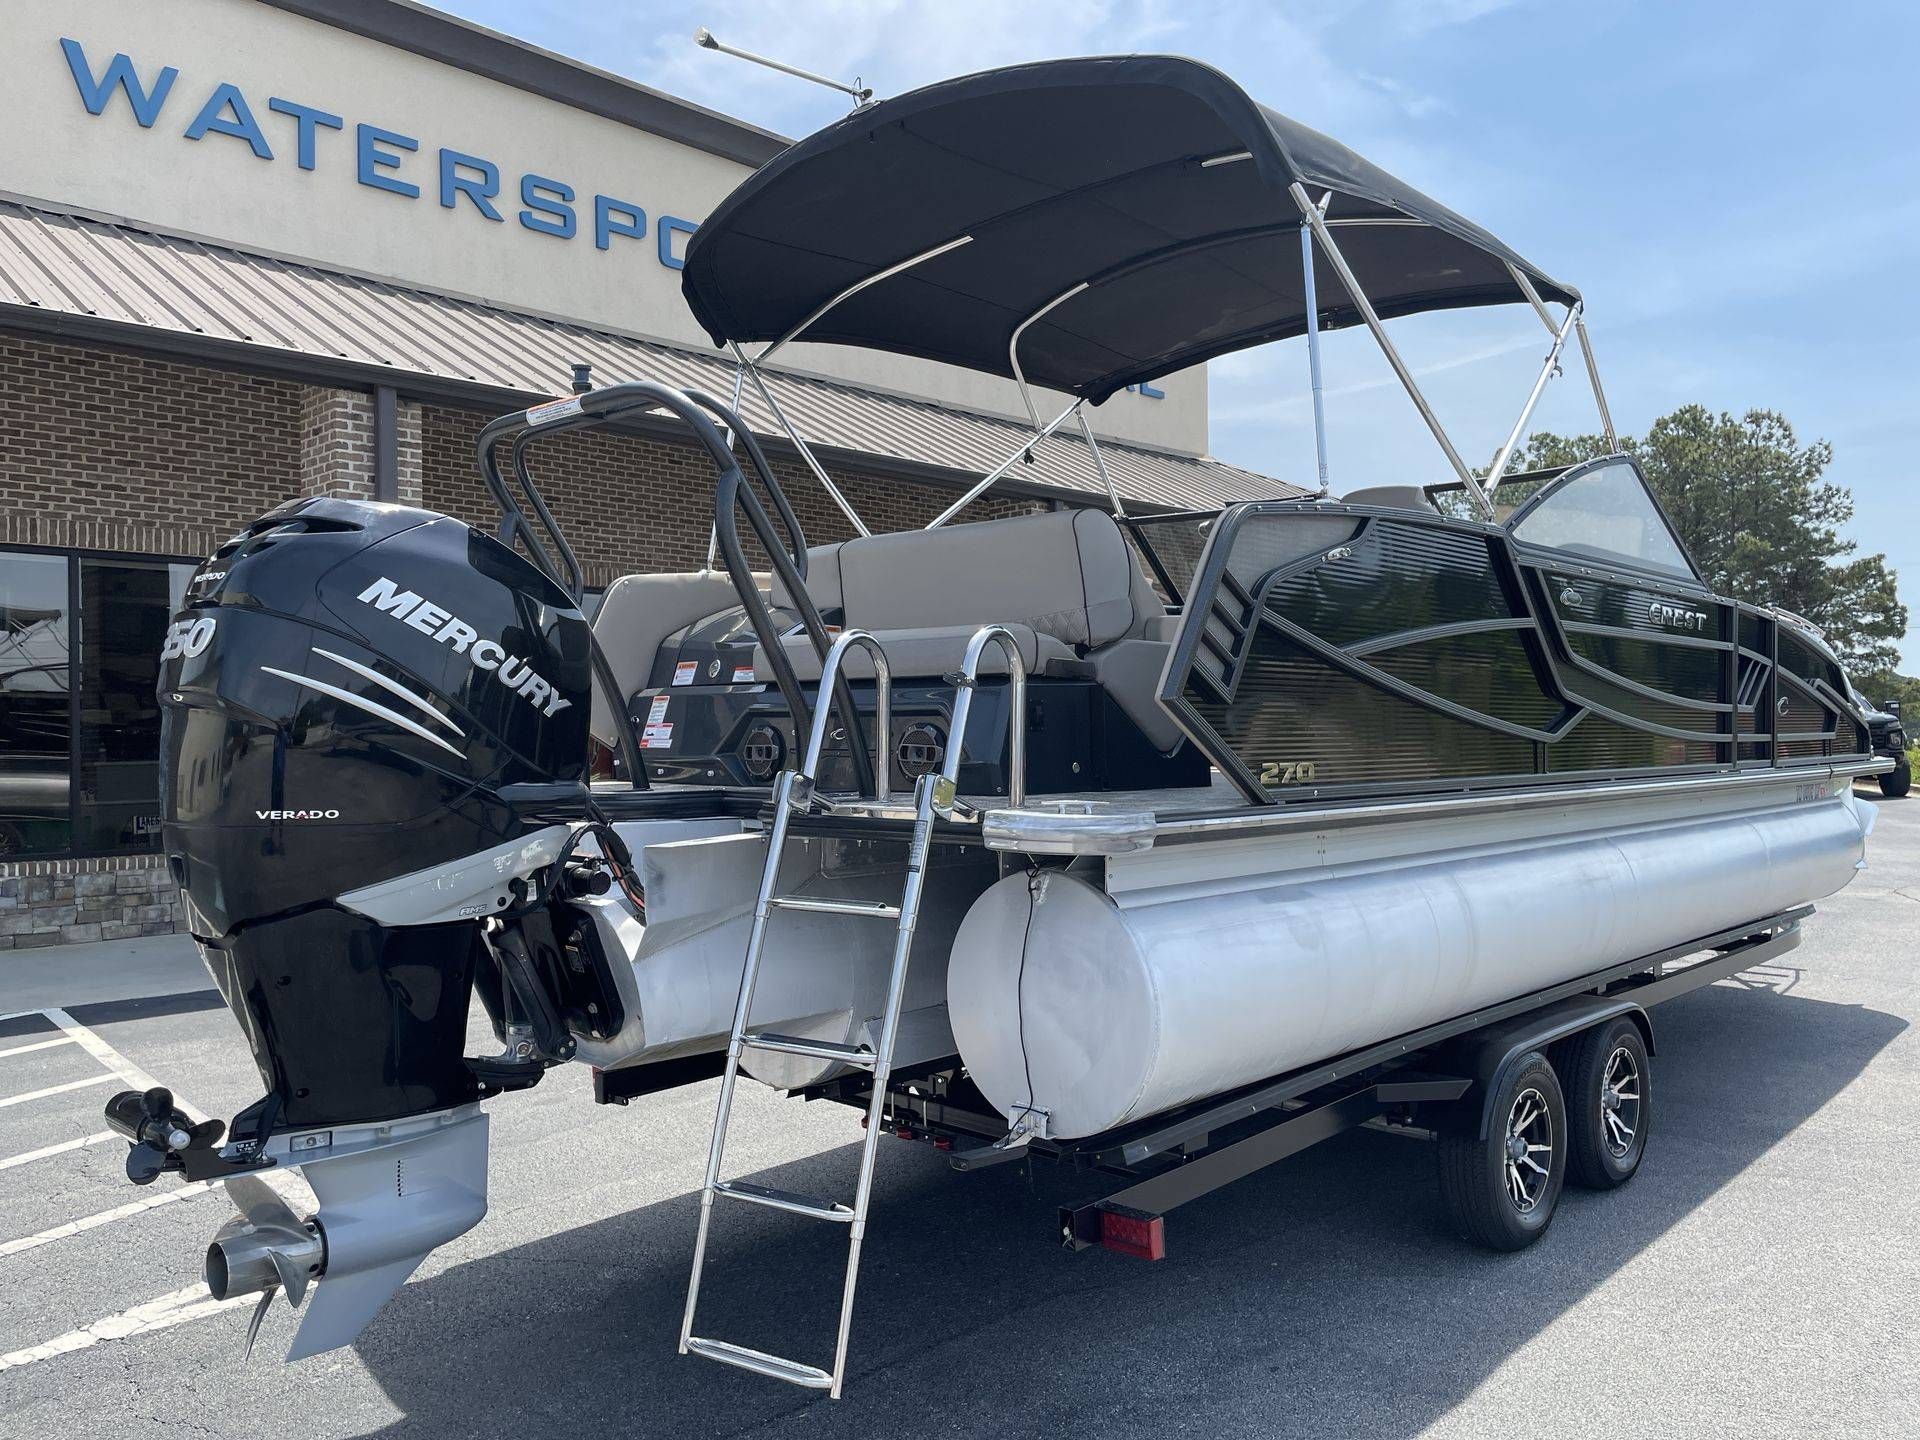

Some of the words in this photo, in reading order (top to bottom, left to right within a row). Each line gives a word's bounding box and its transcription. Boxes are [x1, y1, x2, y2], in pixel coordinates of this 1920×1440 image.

[1649, 603, 1707, 631] CREST
[356, 576, 573, 718] MERCURY
[1260, 762, 1315, 784] 270
[255, 809, 340, 820] VERADO
[459, 904, 488, 917] AMS
